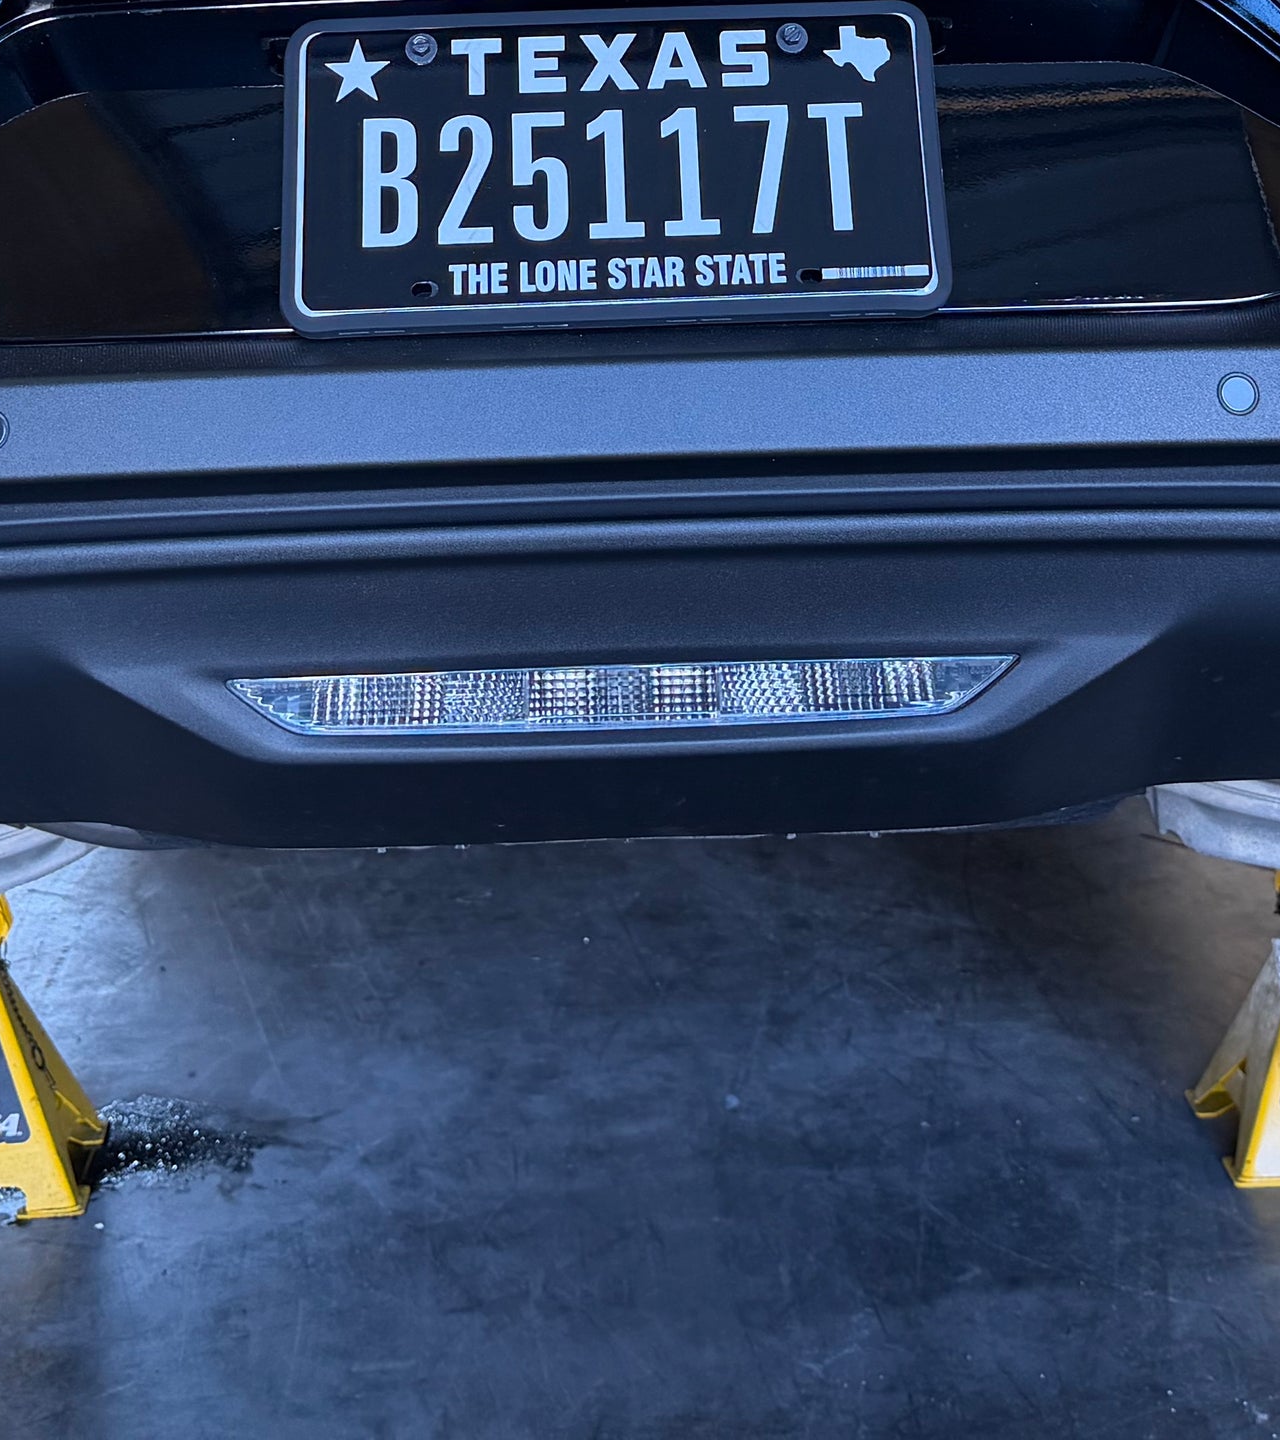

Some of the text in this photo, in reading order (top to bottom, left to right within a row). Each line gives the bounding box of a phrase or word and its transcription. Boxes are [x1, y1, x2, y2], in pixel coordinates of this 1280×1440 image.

[451, 30, 769, 95] TEXAS
[362, 103, 862, 247] B25117T
[449, 253, 786, 295] THE LONE STAR STATE
